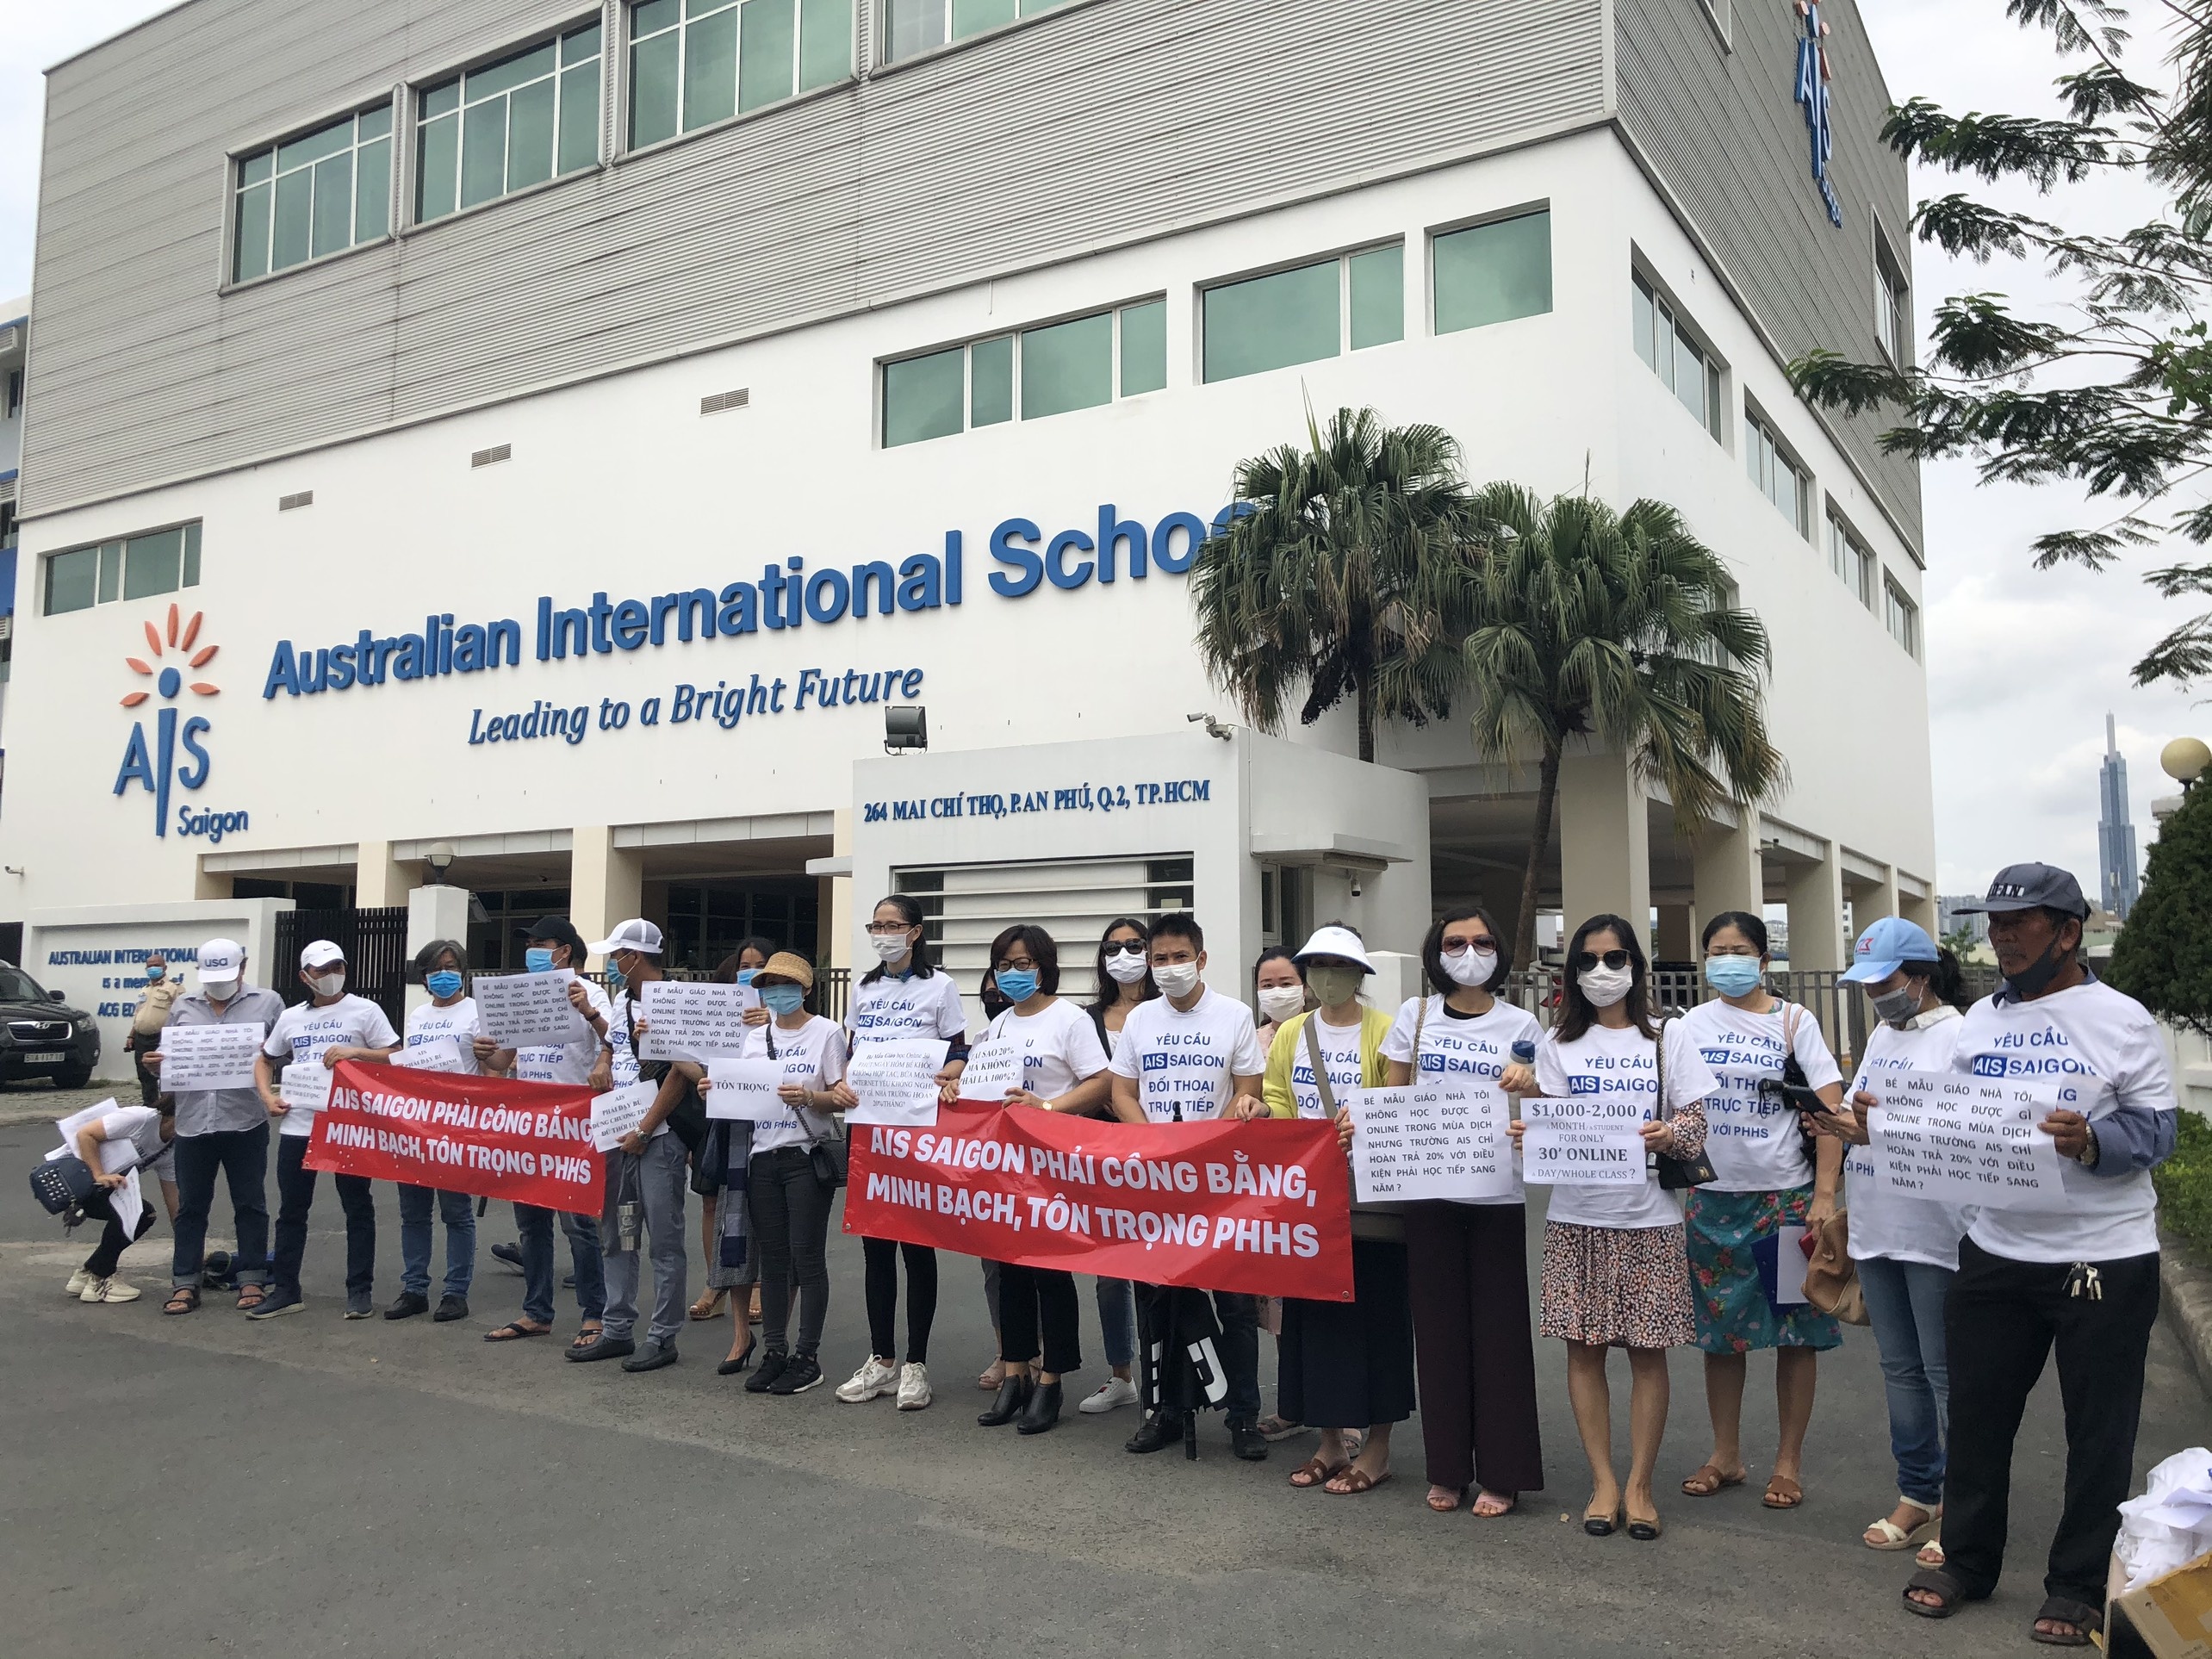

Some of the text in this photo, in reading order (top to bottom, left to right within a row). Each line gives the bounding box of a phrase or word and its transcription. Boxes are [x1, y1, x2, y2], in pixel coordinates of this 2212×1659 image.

[263, 503, 1258, 700] Australian International Scho
[468, 667, 924, 745] Leading to a Bright Future
[113, 707, 210, 837] AIS
[864, 803, 887, 823] 264
[892, 799, 926, 820] MAI
[930, 792, 964, 818] CHÍ
[967, 793, 1007, 819] THỌ,
[1054, 783, 1094, 811] PHÚ,
[1097, 786, 1130, 811] Q.2,
[1135, 780, 1210, 805] TP.HCM
[177, 805, 248, 842] Saigon
[49, 951, 111, 965] AUSTRALIAN
[205, 957, 227, 967] usa
[98, 1003, 119, 1016] ACG
[870, 998, 889, 1009] YÊU
[875, 1016, 923, 1027] SAIGON
[295, 1035, 351, 1047] AIS SAIGON
[1157, 1033, 1179, 1045] YÊU
[1434, 1037, 1462, 1049] YÊU
[1718, 1032, 1746, 1043] YÊU
[1994, 1032, 2023, 1047] YÊU
[1145, 1054, 1224, 1068] AIS SAIGON
[1421, 1056, 1441, 1069] AIS
[1585, 1056, 1614, 1069] YÊU
[1974, 1058, 2002, 1075] AIS
[716, 1080, 769, 1092] TÔN TRỌNG
[1149, 1076, 1214, 1094] ĐỐI THOẠI
[1571, 1078, 1596, 1091] AIS
[1886, 1078, 1897, 1088] BÉ
[1944, 1084, 1970, 1095] GIÁO
[1980, 1087, 2002, 1098] NHÀ
[2014, 1091, 2031, 1103] TÔI
[1185, 1097, 1214, 1112] TIẾP
[1364, 1096, 1375, 1105] BÉ
[1383, 1093, 1405, 1103] MẪU
[1414, 1094, 1437, 1103] GIÁO
[1446, 1090, 1465, 1100] NHÀ
[332, 1087, 359, 1110] AIS
[361, 1091, 432, 1122] SAIGON
[480, 1103, 532, 1135] CÔNG
[1365, 1104, 1490, 1119] KHÔNG HỌC ĐƯỢC GÌ
[1532, 1103, 1637, 1118] $1,000-2,000
[1705, 1097, 1741, 1114] TRỰC
[1886, 1096, 1923, 1108] KHÔNG
[1937, 1101, 1957, 1112] HỌC
[2019, 1109, 2031, 1120] GÌ
[1367, 1121, 1492, 1134] ONLINE TRONG MÙA DỊCH
[1712, 1123, 1768, 1138] VỚI PHHS
[1886, 1113, 1921, 1124] ONLINE
[1928, 1118, 1961, 1129] TRONG
[2003, 1127, 2031, 1139] DỊCH
[1369, 1140, 1402, 1148] NHƯNG
[1410, 1136, 1449, 1146] TRƯỜNG
[1478, 1133, 1493, 1143] CHỈ
[1985, 1142, 2002, 1153] AIS
[326, 1122, 591, 1184] MINH BẠCH, TÔN TRỌNG PHHS
[1370, 1153, 1395, 1163] HOÀN
[1402, 1151, 1420, 1161] TRẢ
[1451, 1150, 1466, 1159] VỚI
[1473, 1148, 1494, 1159] ĐIỀU
[1567, 1148, 1627, 1161] ONLINE
[1887, 1145, 1914, 1157] HOÀN
[1950, 1153, 1972, 1165] 20%
[1979, 1157, 1998, 1168] VỚI
[871, 1128, 1316, 1207] AIS SAIGON PHẢI CÔNG BẰNG,
[1371, 1169, 1391, 1178] KIỆN
[1396, 1166, 1417, 1177] PHẢI
[1423, 1167, 1442, 1177] HỌC
[1447, 1164, 1465, 1174] TIẾP
[1538, 1169, 1596, 1178] DAY/WHOLE
[1948, 1169, 1971, 1180] HỌC
[2007, 1177, 2039, 1188] SANG
[867, 1172, 1320, 1258] MINH BẠCH, TÔN TRỌNG PHHS
